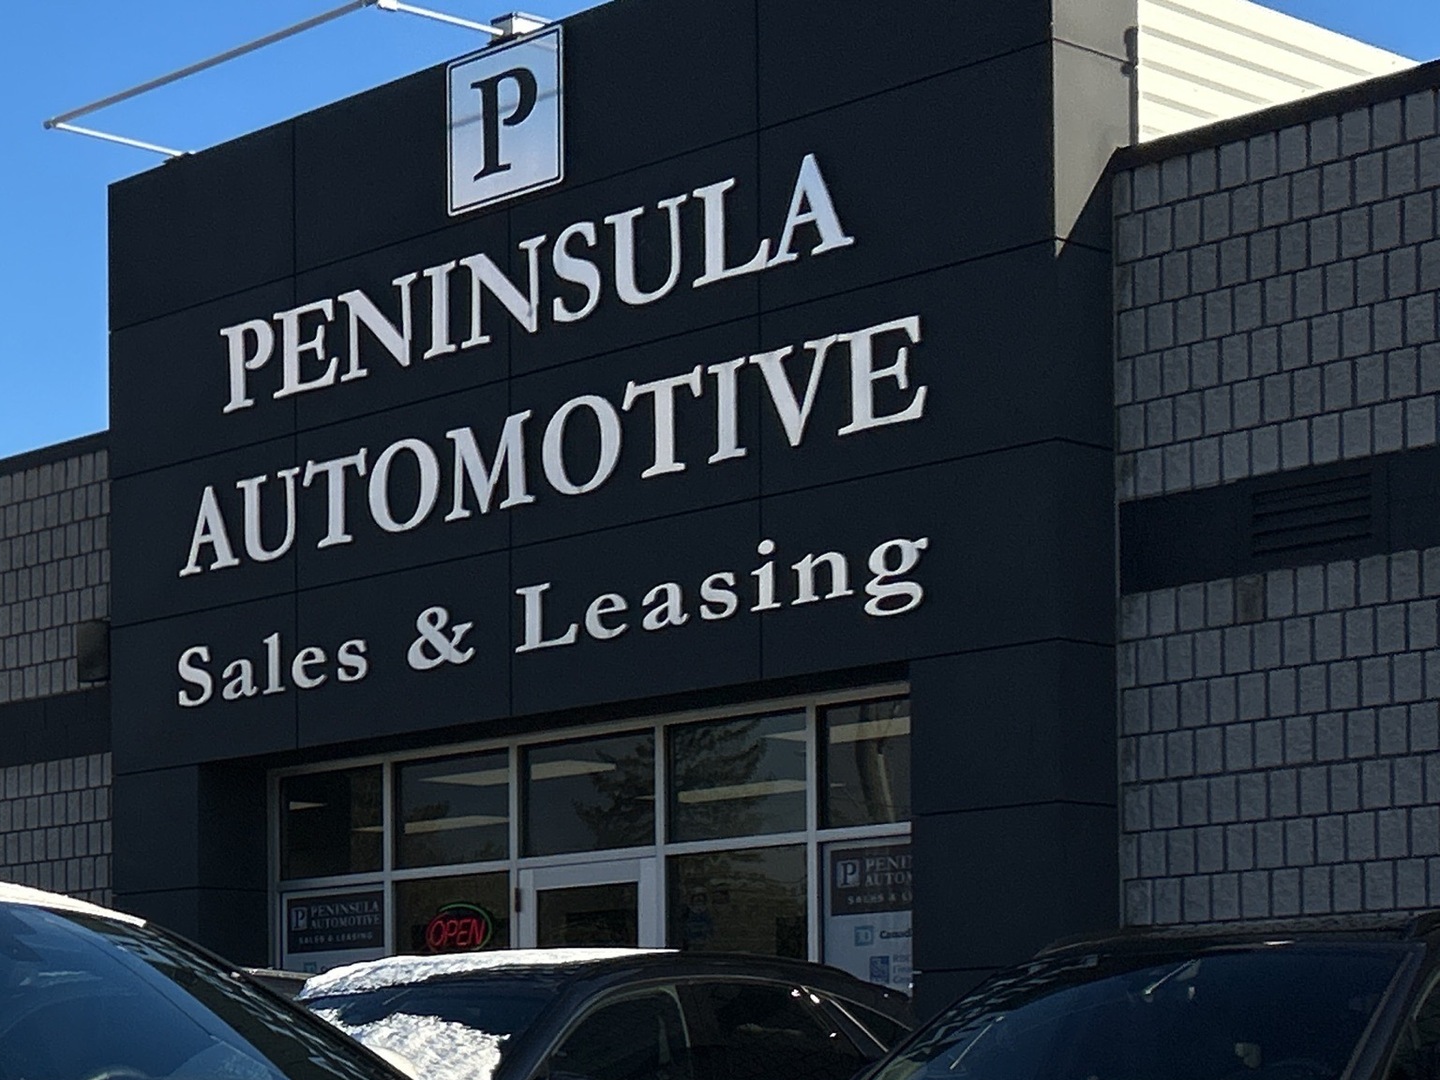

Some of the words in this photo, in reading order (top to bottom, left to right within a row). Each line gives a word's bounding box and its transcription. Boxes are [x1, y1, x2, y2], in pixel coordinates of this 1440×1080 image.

[470, 66, 537, 182] P
[219, 153, 855, 414] PENINSULA
[178, 315, 929, 578] AUTOMOTIVE
[177, 632, 369, 707] Sales
[406, 605, 475, 671] &
[515, 536, 930, 654] Leasing
[841, 863, 856, 886] P
[865, 855, 912, 872] PENI
[294, 909, 305, 929] P
[311, 901, 379, 918] PENINSULA
[311, 914, 381, 930] AUTOMOTIVE
[428, 918, 486, 947] OPEN
[298, 934, 325, 945] SALES
[336, 931, 373, 942] LEASING
